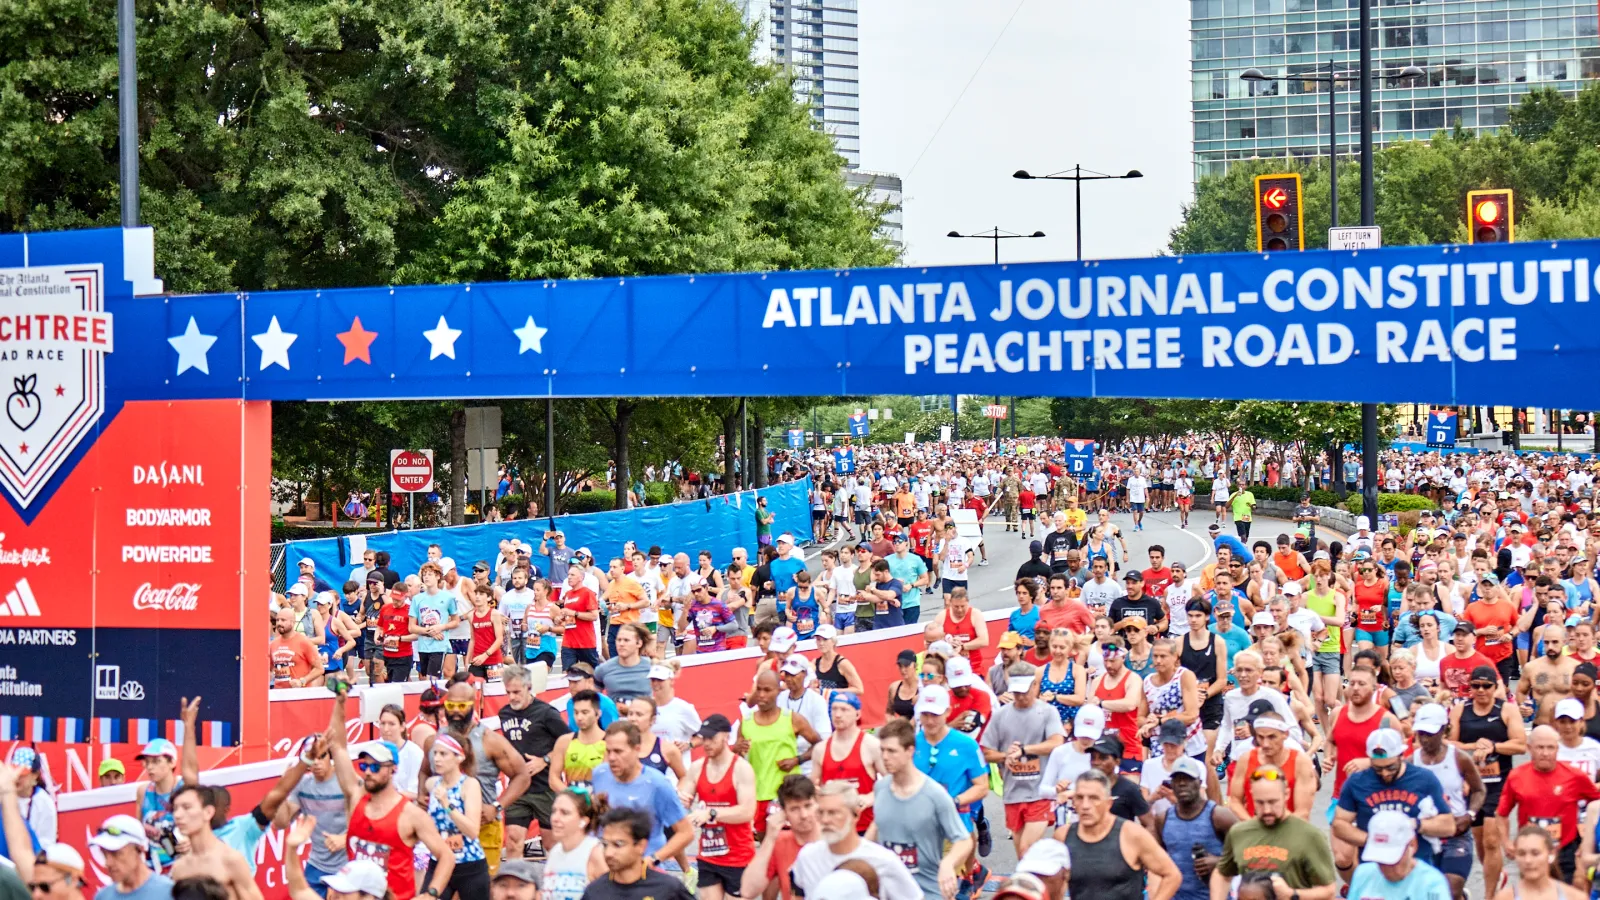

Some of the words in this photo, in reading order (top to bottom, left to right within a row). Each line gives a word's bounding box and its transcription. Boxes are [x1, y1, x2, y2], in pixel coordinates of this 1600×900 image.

[1338, 232, 1352, 240] LEFT
[1355, 232, 1371, 240] TURN
[1344, 242, 1366, 250] YIELD
[18, 273, 50, 285] Atlanta
[762, 281, 977, 328] ATLANTA
[990, 257, 1600, 322] JOURNAL-CONSTITUTI
[904, 326, 1181, 375] PEACHTREE
[1202, 322, 1355, 368] ROAD
[1376, 317, 1517, 363] RACE
[27, 349, 64, 361] RACE
[1437, 431, 1446, 442] D
[842, 463, 848, 471] D
[1075, 460, 1083, 471] D
[133, 460, 204, 488] DASANI
[400, 476, 424, 484] ENTER
[126, 508, 211, 526] BODYARMOR
[122, 545, 212, 563] POWERADE
[133, 582, 202, 610] Coca-Cola
[18, 630, 77, 645] PARTNERS
[1365, 789, 1419, 808] FREEDOM
